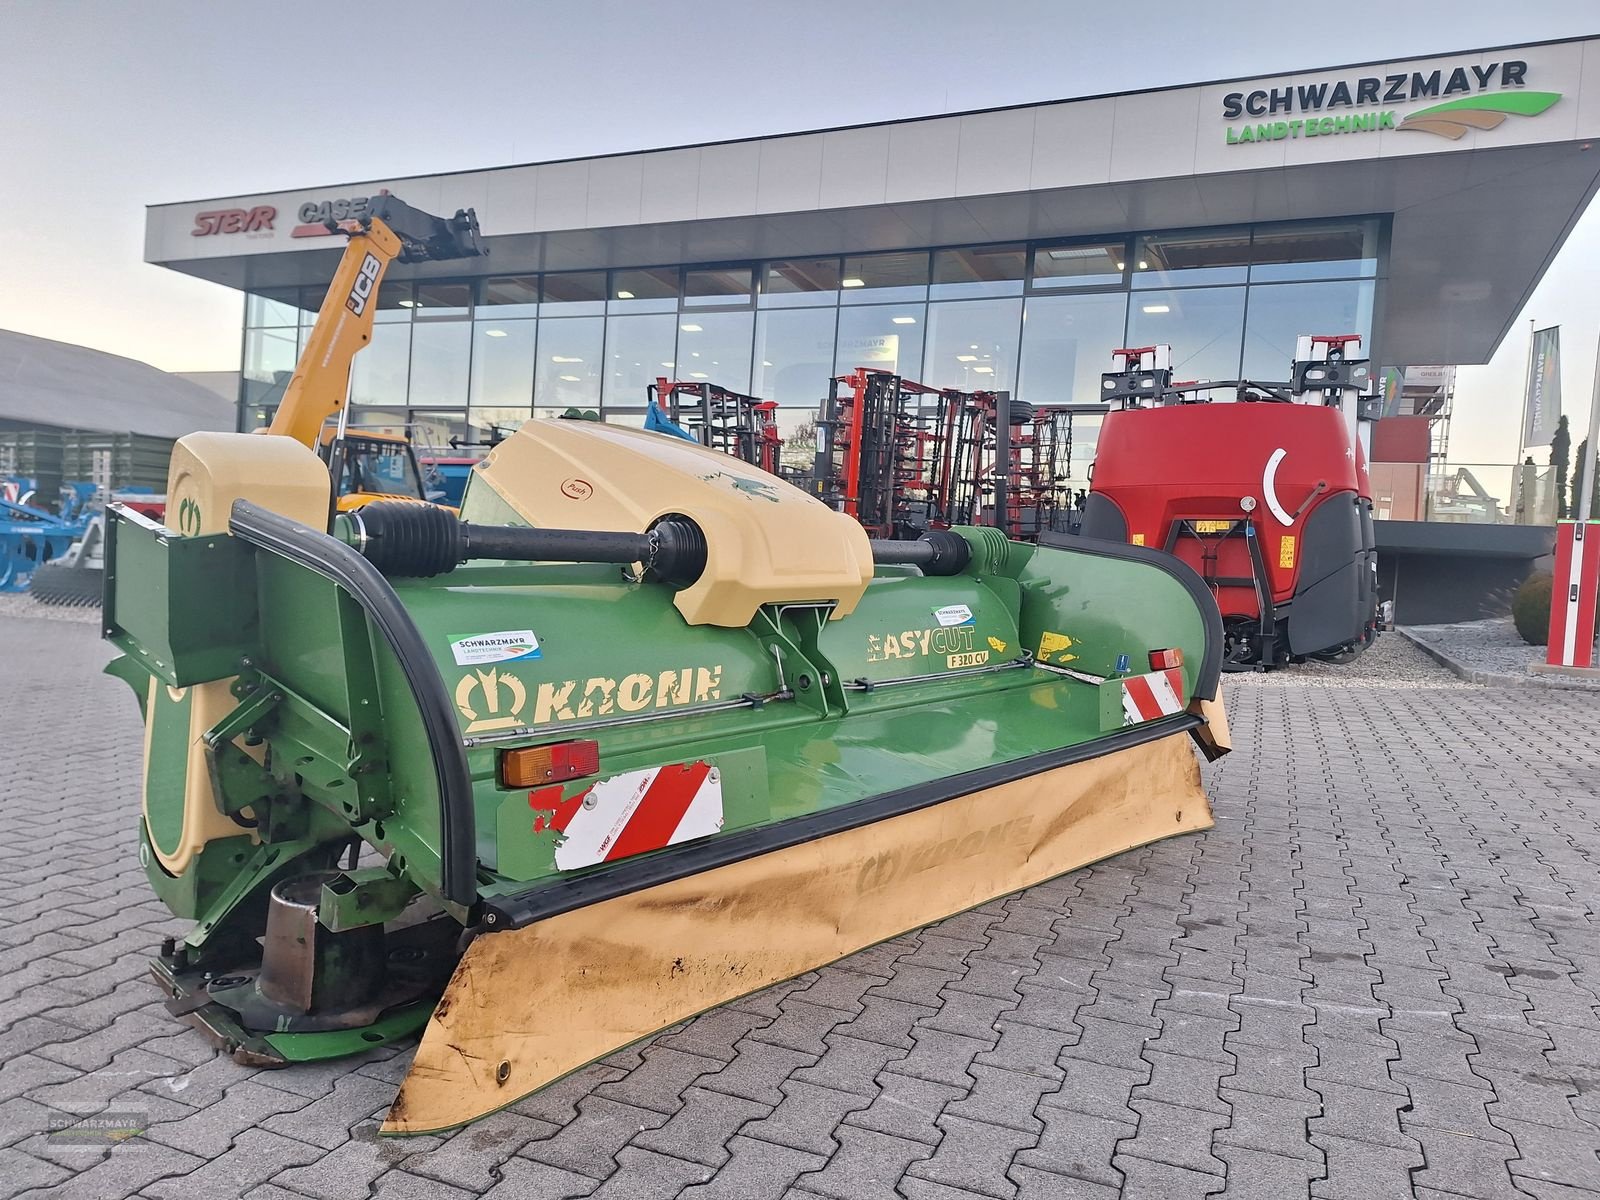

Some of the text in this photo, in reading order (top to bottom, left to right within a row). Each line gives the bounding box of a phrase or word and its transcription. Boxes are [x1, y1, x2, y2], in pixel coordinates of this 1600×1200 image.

[1223, 60, 1528, 119] SCHWARZMAYR
[1226, 110, 1396, 145] LANDTECHNIK
[191, 205, 277, 237] STEYR
[298, 197, 369, 224] CASE
[348, 253, 381, 316] JCB
[567, 484, 586, 496] Push
[459, 637, 526, 648] SCHWARZMAYR
[951, 652, 986, 667] F 320 CV
